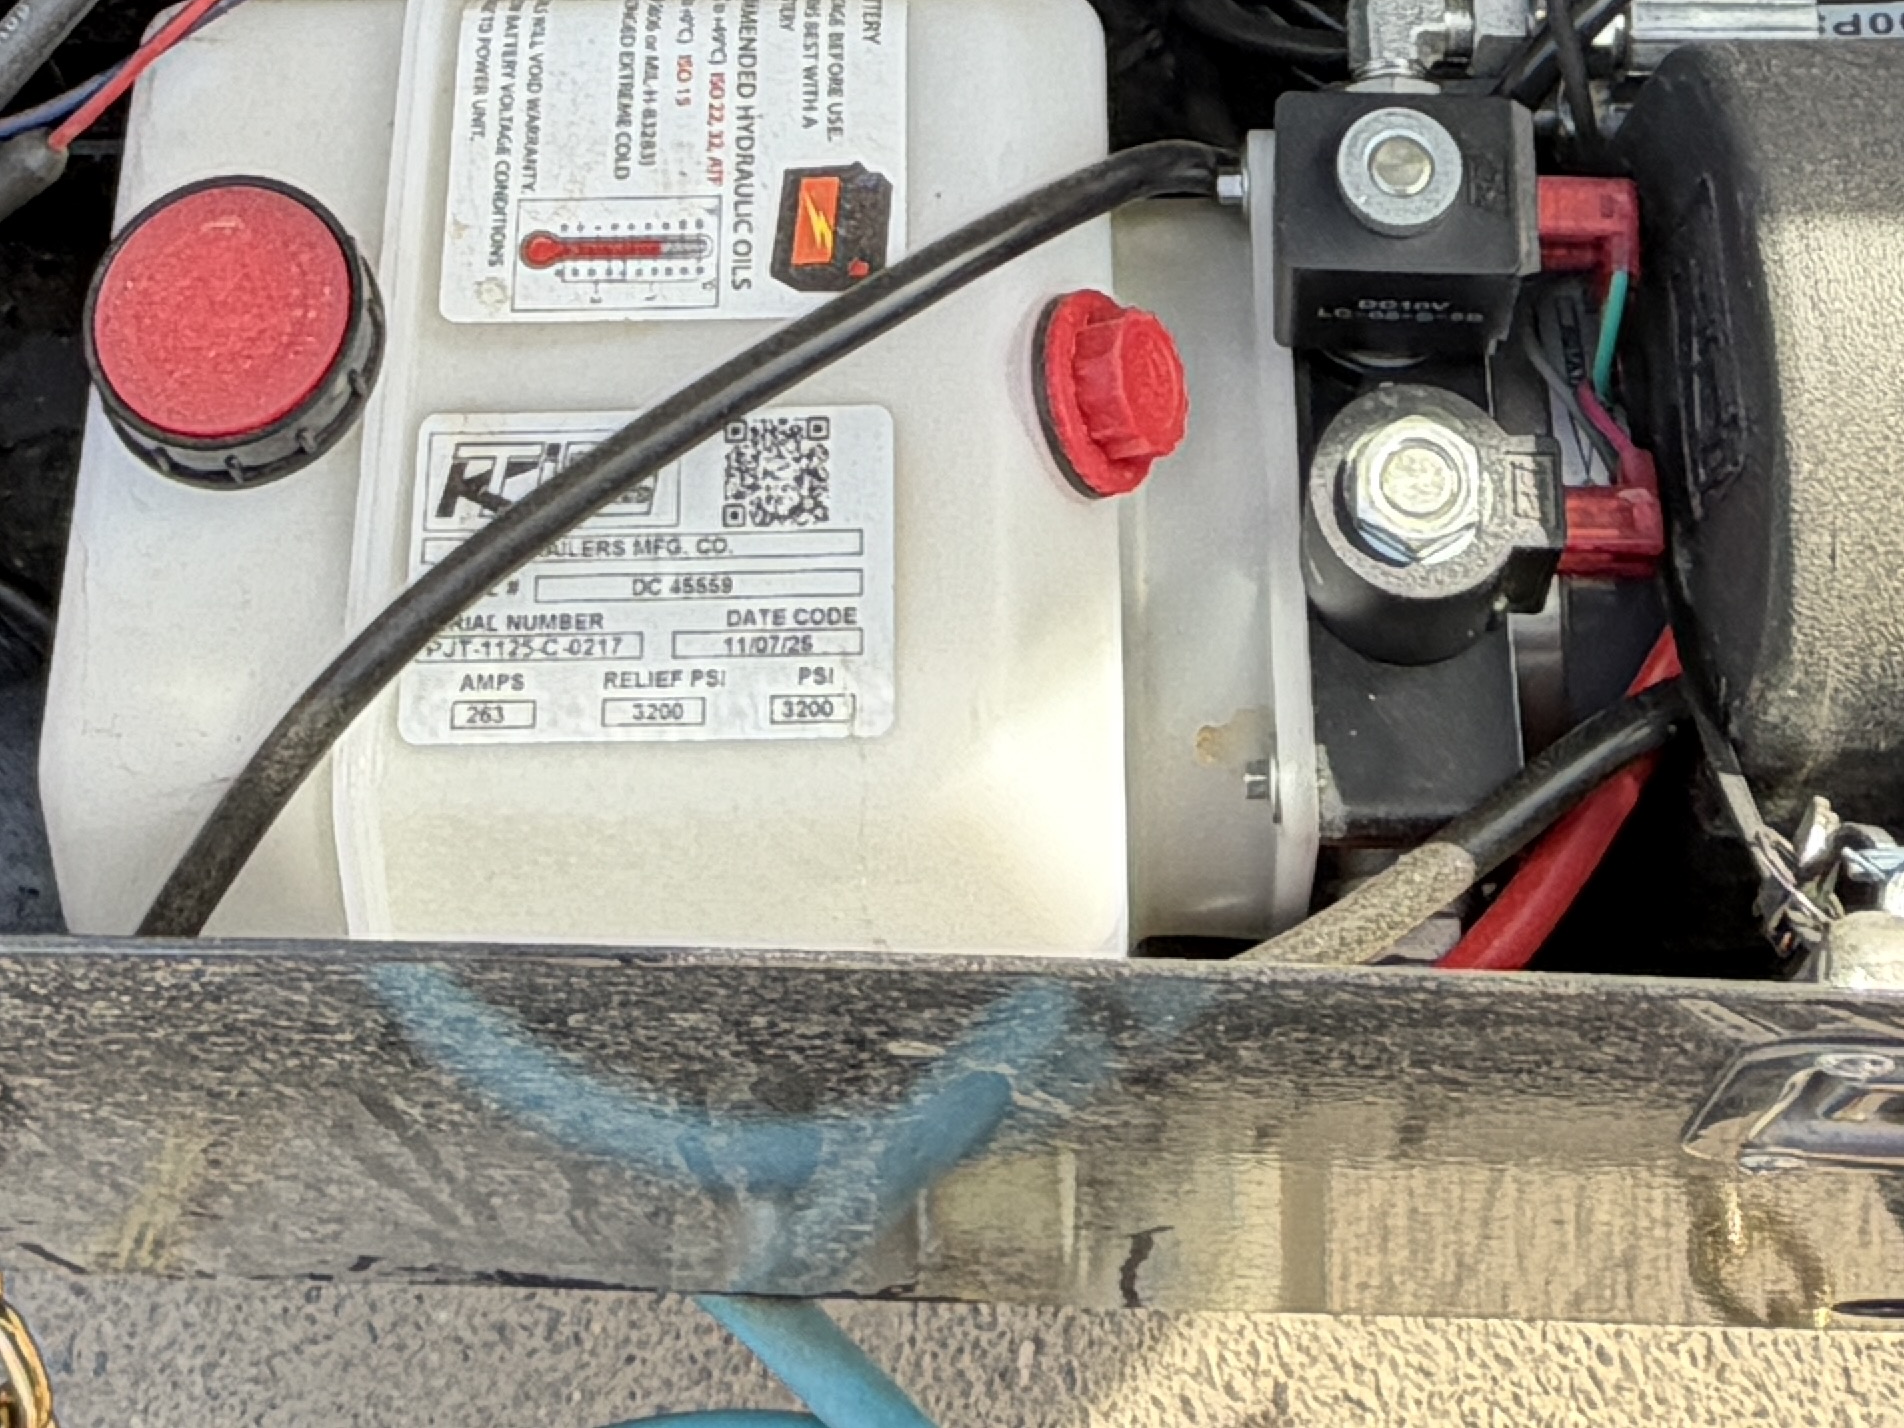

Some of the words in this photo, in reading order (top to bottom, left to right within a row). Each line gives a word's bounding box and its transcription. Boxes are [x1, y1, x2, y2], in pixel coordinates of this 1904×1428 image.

[500, 14, 519, 78] BATTERY
[528, 16, 545, 49] WILL
[802, 21, 818, 62] BEST
[473, 37, 492, 95] POWER
[526, 54, 544, 93] VOID
[676, 54, 692, 82] ISO
[827, 32, 843, 96] BEFORE
[615, 51, 634, 127] EXTREME
[708, 72, 725, 99] ISO
[802, 66, 818, 110] WITH
[469, 98, 489, 141] UNIT.
[495, 83, 515, 156] VOLTAGE
[707, 101, 724, 126] 22,
[802, 115, 817, 129] A
[826, 102, 842, 142] USE.
[520, 98, 540, 194] WARRANTY.
[614, 131, 631, 179] COLD
[706, 156, 723, 188] ATF
[731, 104, 755, 234] HYDRAULIC
[487, 160, 509, 266] CONDITIONS
[730, 238, 752, 290] OILS
[547, 540, 626, 558] AILERS
[633, 539, 689, 556] MFG.
[695, 538, 733, 555] CO.
[632, 577, 662, 597] DC
[449, 614, 498, 632] RIAL
[506, 612, 604, 631] NUMBER
[726, 608, 786, 627] DATE
[793, 606, 857, 626] CODE
[459, 673, 526, 692] AMPS
[603, 670, 684, 690] RELIEF
[690, 669, 727, 688] PSI
[798, 666, 834, 685] PSI
[466, 705, 506, 725] 263
[632, 702, 685, 722] 3200
[781, 699, 834, 719] 3200
